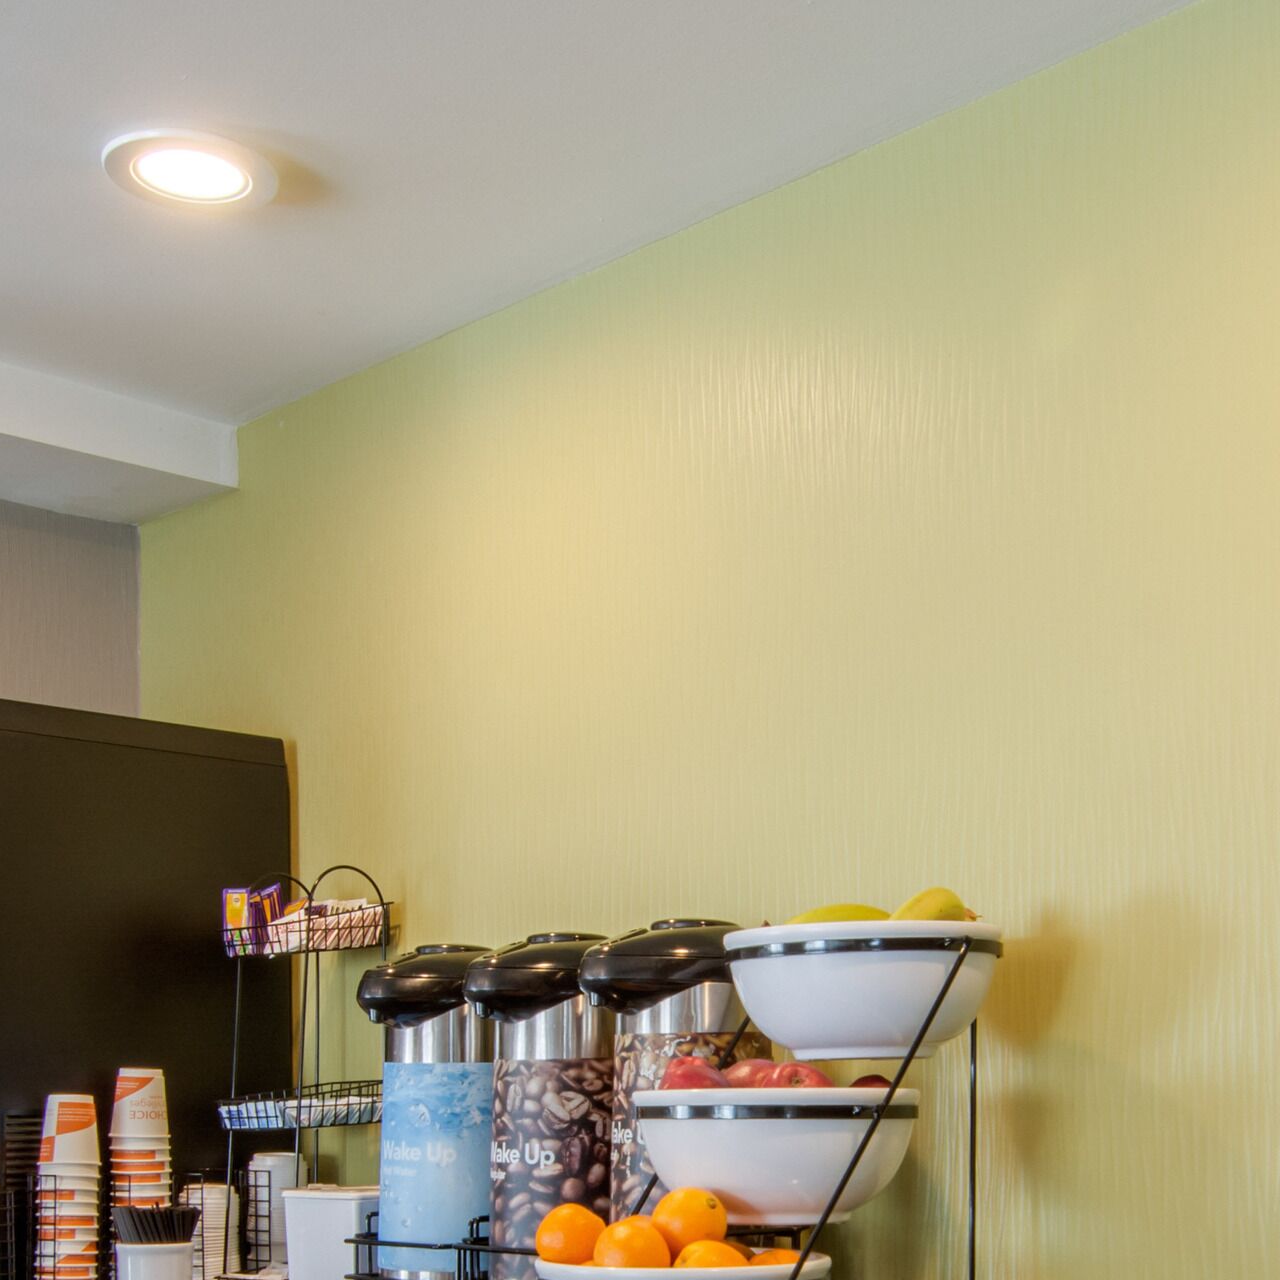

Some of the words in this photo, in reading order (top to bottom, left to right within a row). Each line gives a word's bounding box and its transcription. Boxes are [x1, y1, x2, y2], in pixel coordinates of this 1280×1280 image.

[612, 1120, 633, 1144] ake
[384, 1140, 421, 1161] Wake
[426, 1141, 457, 1168] Up
[524, 1143, 555, 1169] Up
